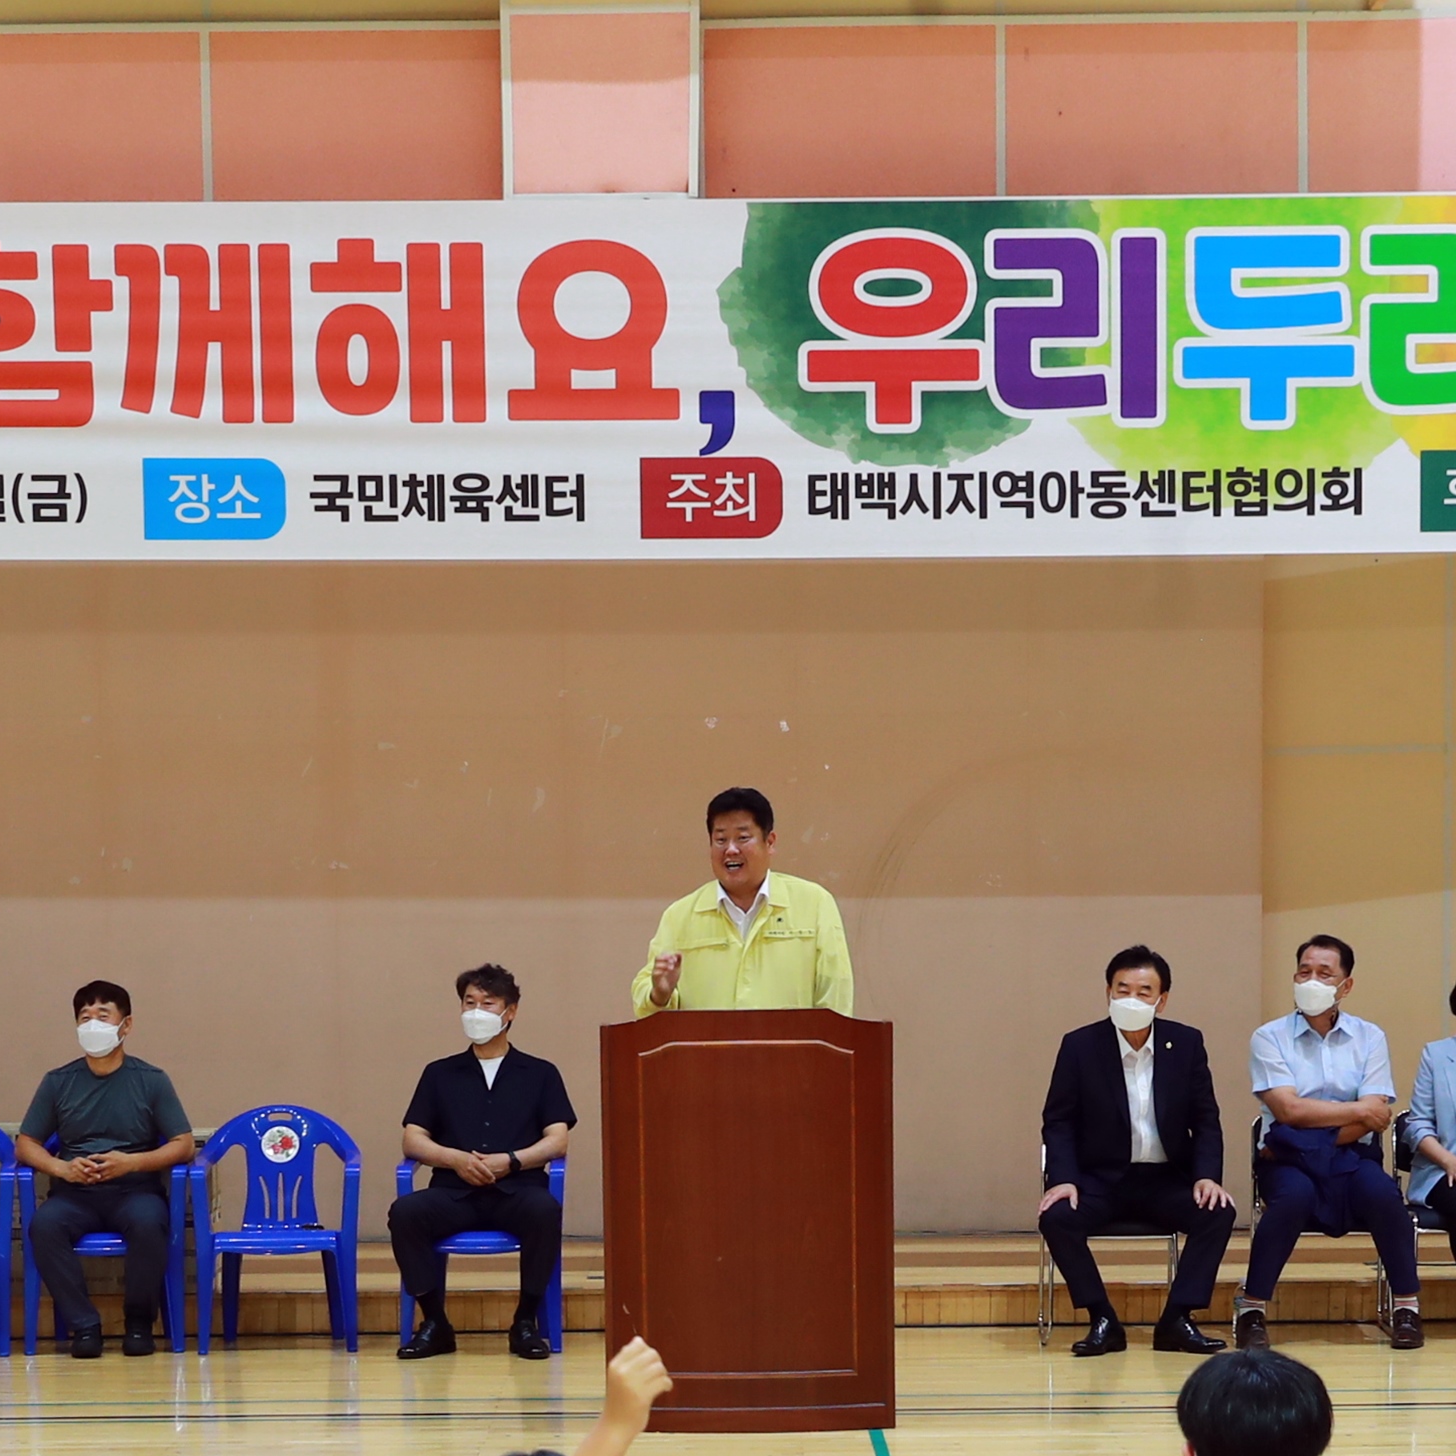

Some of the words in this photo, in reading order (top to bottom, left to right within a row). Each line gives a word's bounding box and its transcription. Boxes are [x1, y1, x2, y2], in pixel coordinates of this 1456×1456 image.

[167, 473, 262, 524] 장소
[308, 471, 586, 524] 국민체육센터
[665, 471, 758, 523] 주최
[806, 465, 1364, 522] 태백시지역아동센터협의회
